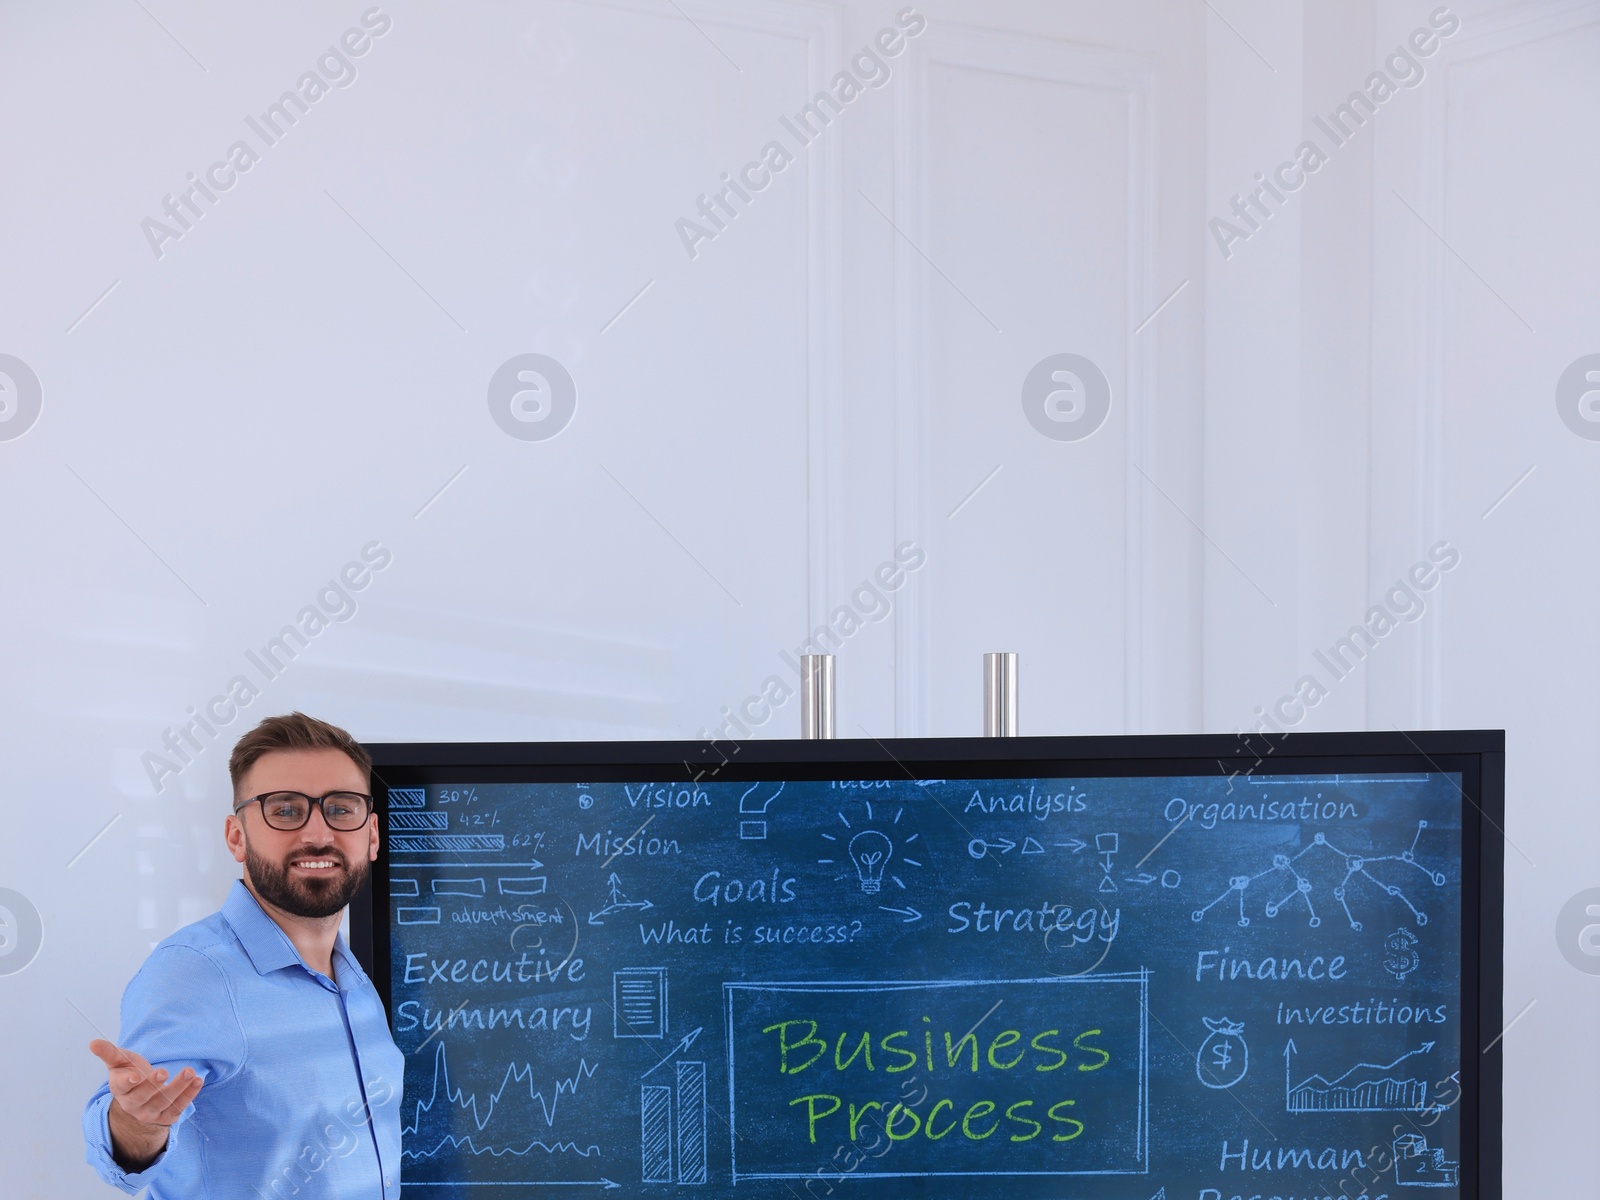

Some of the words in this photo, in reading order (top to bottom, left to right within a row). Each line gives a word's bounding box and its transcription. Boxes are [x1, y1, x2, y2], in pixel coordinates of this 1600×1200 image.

[439, 787, 479, 806] 30%
[624, 783, 712, 808] Vision
[965, 786, 1088, 821] Analysis
[1163, 793, 1359, 829] Organisation
[460, 810, 500, 827] 42%
[512, 831, 546, 855] 62%
[575, 830, 682, 857] Mission
[693, 870, 797, 906] Goals
[640, 920, 711, 944] What
[725, 920, 742, 943] is
[754, 921, 861, 943] success?
[947, 902, 1121, 942] Strategy
[403, 949, 586, 983] Executive
[1195, 946, 1348, 982] Finance
[397, 1001, 593, 1042] Summary
[1276, 998, 1448, 1025] Investitions
[764, 1018, 1109, 1074] Business
[790, 1095, 1083, 1142] Process
[1220, 1139, 1366, 1171] Human
